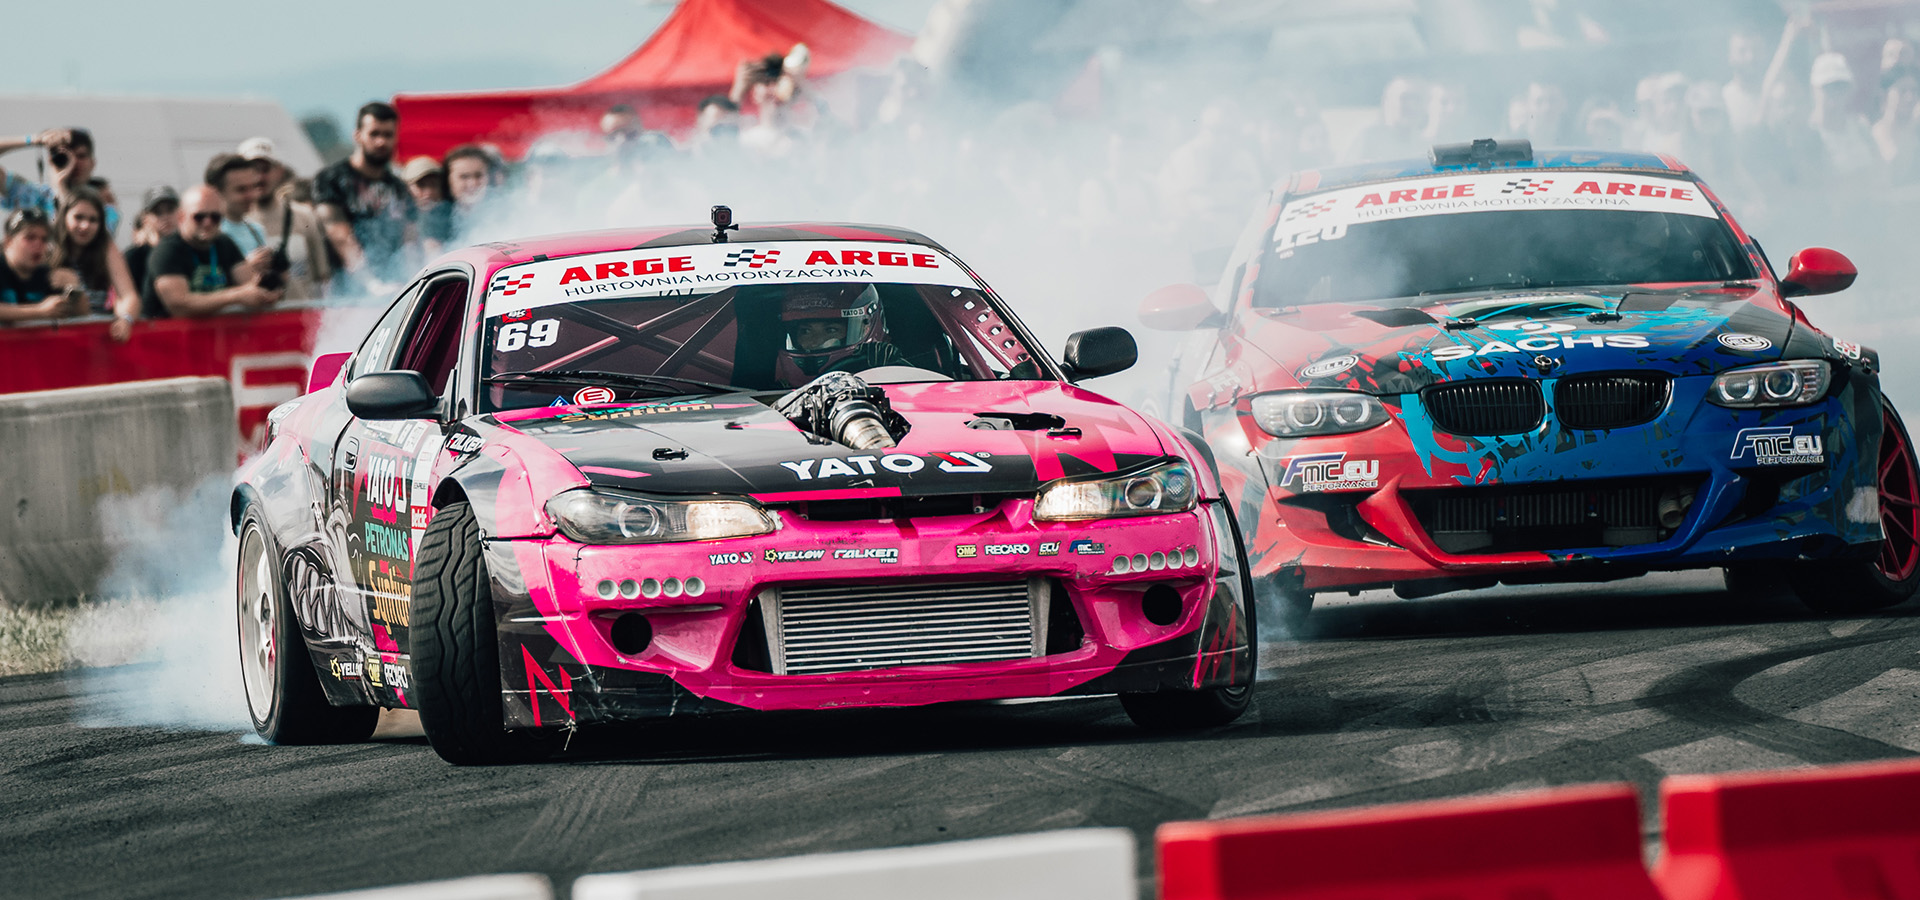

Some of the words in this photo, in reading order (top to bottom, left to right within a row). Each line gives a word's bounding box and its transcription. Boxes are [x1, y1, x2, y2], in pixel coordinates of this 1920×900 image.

[1355, 184, 1475, 208] ARGE
[1573, 181, 1693, 201] ARGE
[1357, 200, 1468, 218] HURTOWNIA
[1474, 197, 1630, 207] MOTORYZACYJNA
[560, 255, 695, 285] ARGE
[805, 250, 939, 268] ARGE
[565, 275, 692, 297] HURTOWNIA
[696, 269, 873, 284] MOTORYZACYJNA
[842, 309, 858, 317] YATO
[496, 318, 560, 352] 69
[1431, 335, 1650, 361] SACHS
[780, 453, 925, 480] YATO
[1757, 455, 1824, 465] PERFORMANCE
[366, 455, 396, 508] YATO
[1303, 480, 1379, 492] PERFORMANCE
[365, 521, 409, 561] PETRONAS
[957, 546, 977, 556] OMP
[985, 544, 1030, 555] RECARO
[709, 553, 739, 566] YATO
[777, 549, 825, 561] YELLOW
